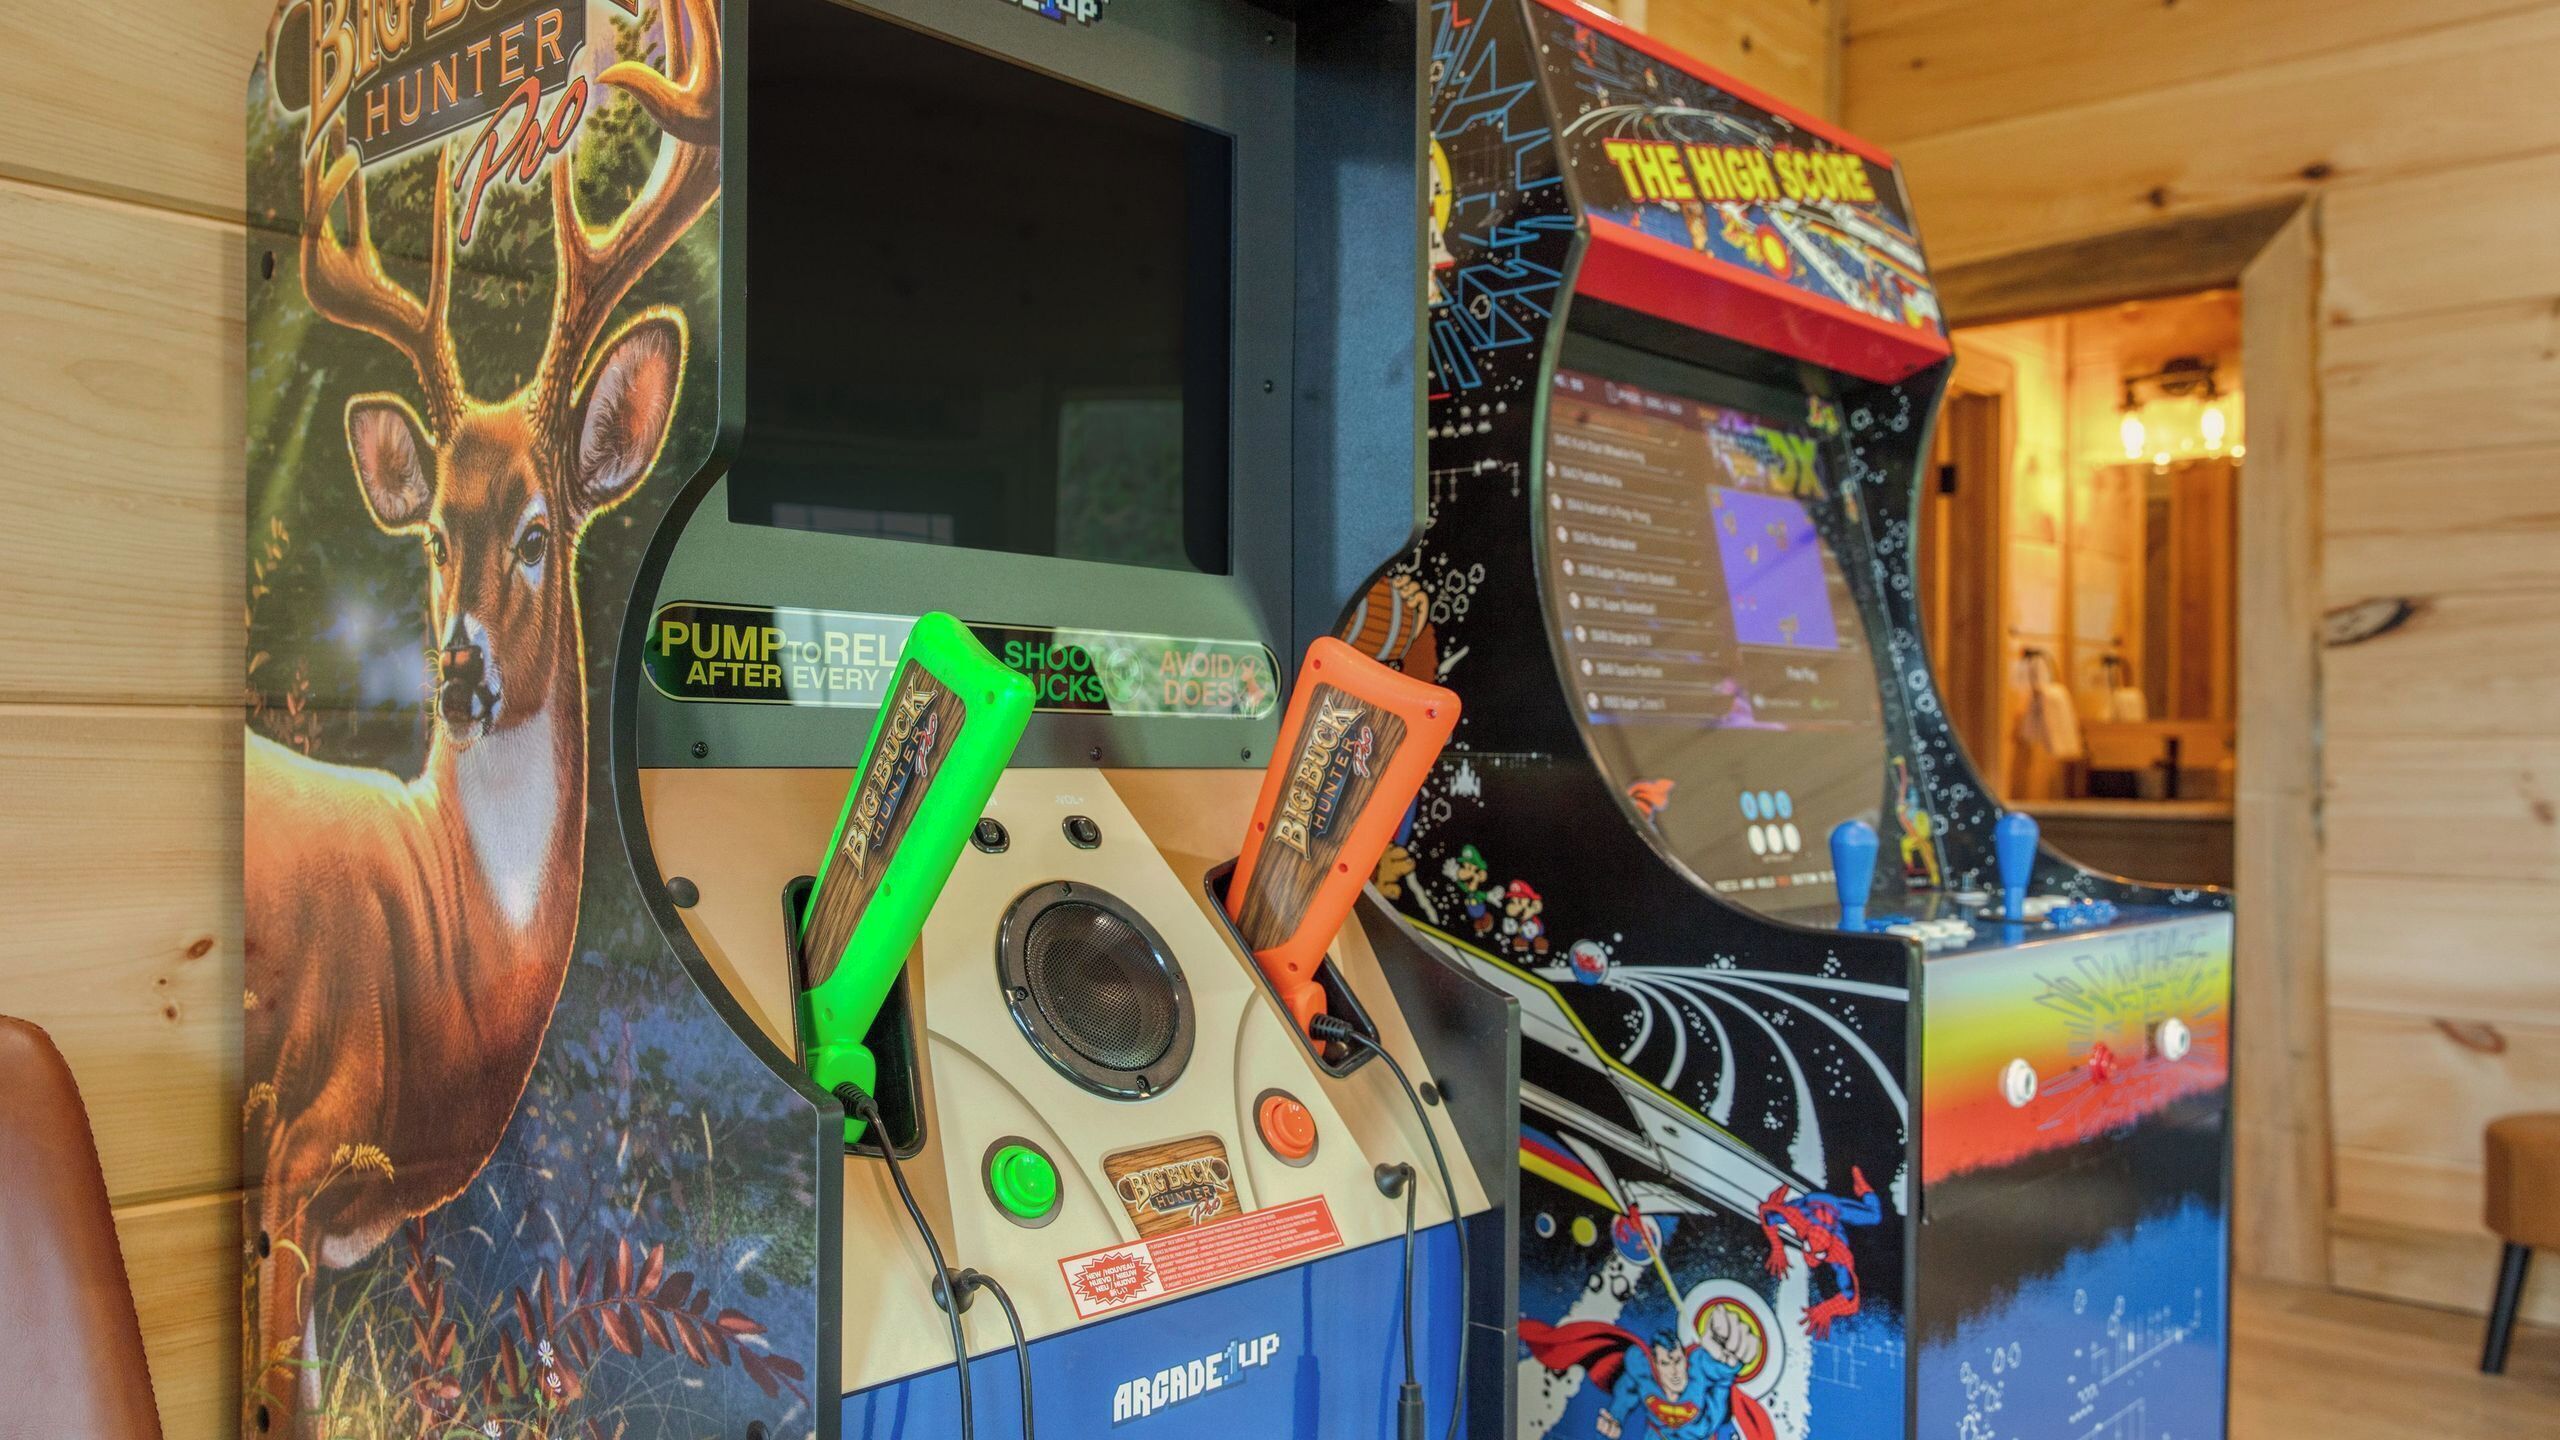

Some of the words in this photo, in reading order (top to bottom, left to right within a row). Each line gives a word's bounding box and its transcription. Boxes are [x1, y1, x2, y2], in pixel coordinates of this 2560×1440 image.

[364, 7, 565, 142] HUNTER
[453, 75, 589, 246] Pro
[1603, 138, 1695, 202] THE
[1685, 145, 1780, 202] HIGH
[1773, 147, 1876, 202] SCORE
[662, 621, 787, 661] PUMP
[788, 641, 822, 664] TO
[824, 632, 907, 667] REL
[1004, 640, 1105, 672] SHOOT
[686, 661, 782, 688] AFTER
[792, 666, 879, 690] EVERY
[1160, 651, 1235, 679] AVOID
[1029, 674, 1105, 702] UCKS
[1164, 680, 1233, 707] DOES
[842, 787, 882, 880] BIG
[872, 672, 938, 794] BUCK
[873, 726, 923, 840] HUNTER
[1273, 785, 1317, 861] BIG
[1298, 694, 1366, 793] BUCK
[1313, 737, 1354, 829] HUNTER
[1125, 1169, 1167, 1210] BIG
[1164, 1157, 1228, 1190] BUCK
[1155, 1185, 1212, 1208] HUNTER
[1086, 1270, 1101, 1280] NEW
[1089, 1276, 1112, 1288] NUEVO
[1095, 1284, 1110, 1293] NEU
[1114, 1277, 1137, 1288] NUOVO
